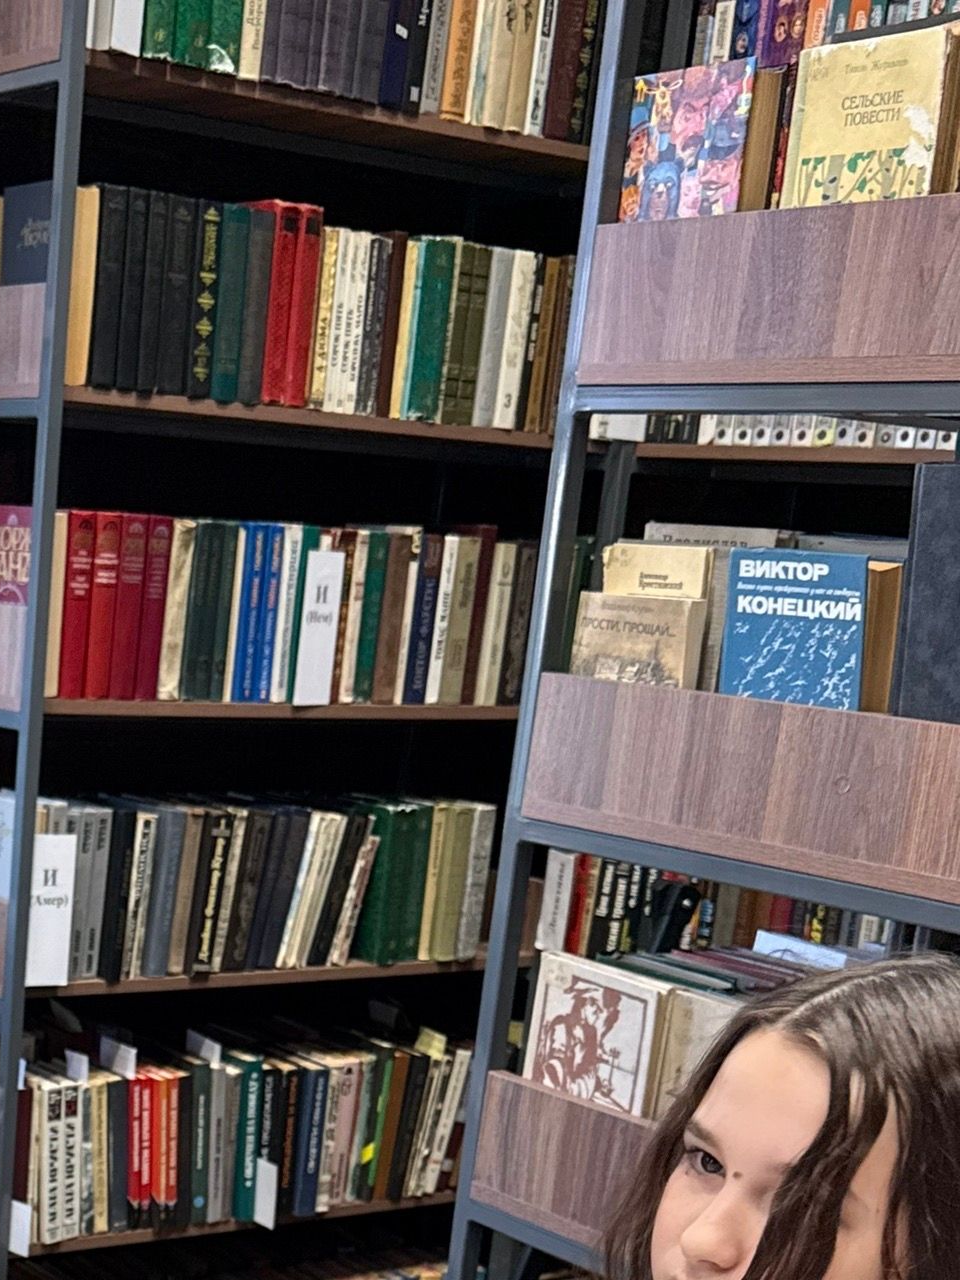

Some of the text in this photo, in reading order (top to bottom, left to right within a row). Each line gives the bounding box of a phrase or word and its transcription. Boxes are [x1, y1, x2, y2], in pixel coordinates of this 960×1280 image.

[841, 90, 904, 111] СЕЛЬСКИЕ
[844, 107, 900, 127] ПОВЕСТИ
[739, 559, 830, 581] ВИКТОР
[737, 595, 862, 622] КОНЕЦКИЙ
[43, 868, 58, 887] И
[66, 1122, 74, 1178] КРИСТИ
[48, 1126, 58, 1224] АГАТА КРИСТИ
